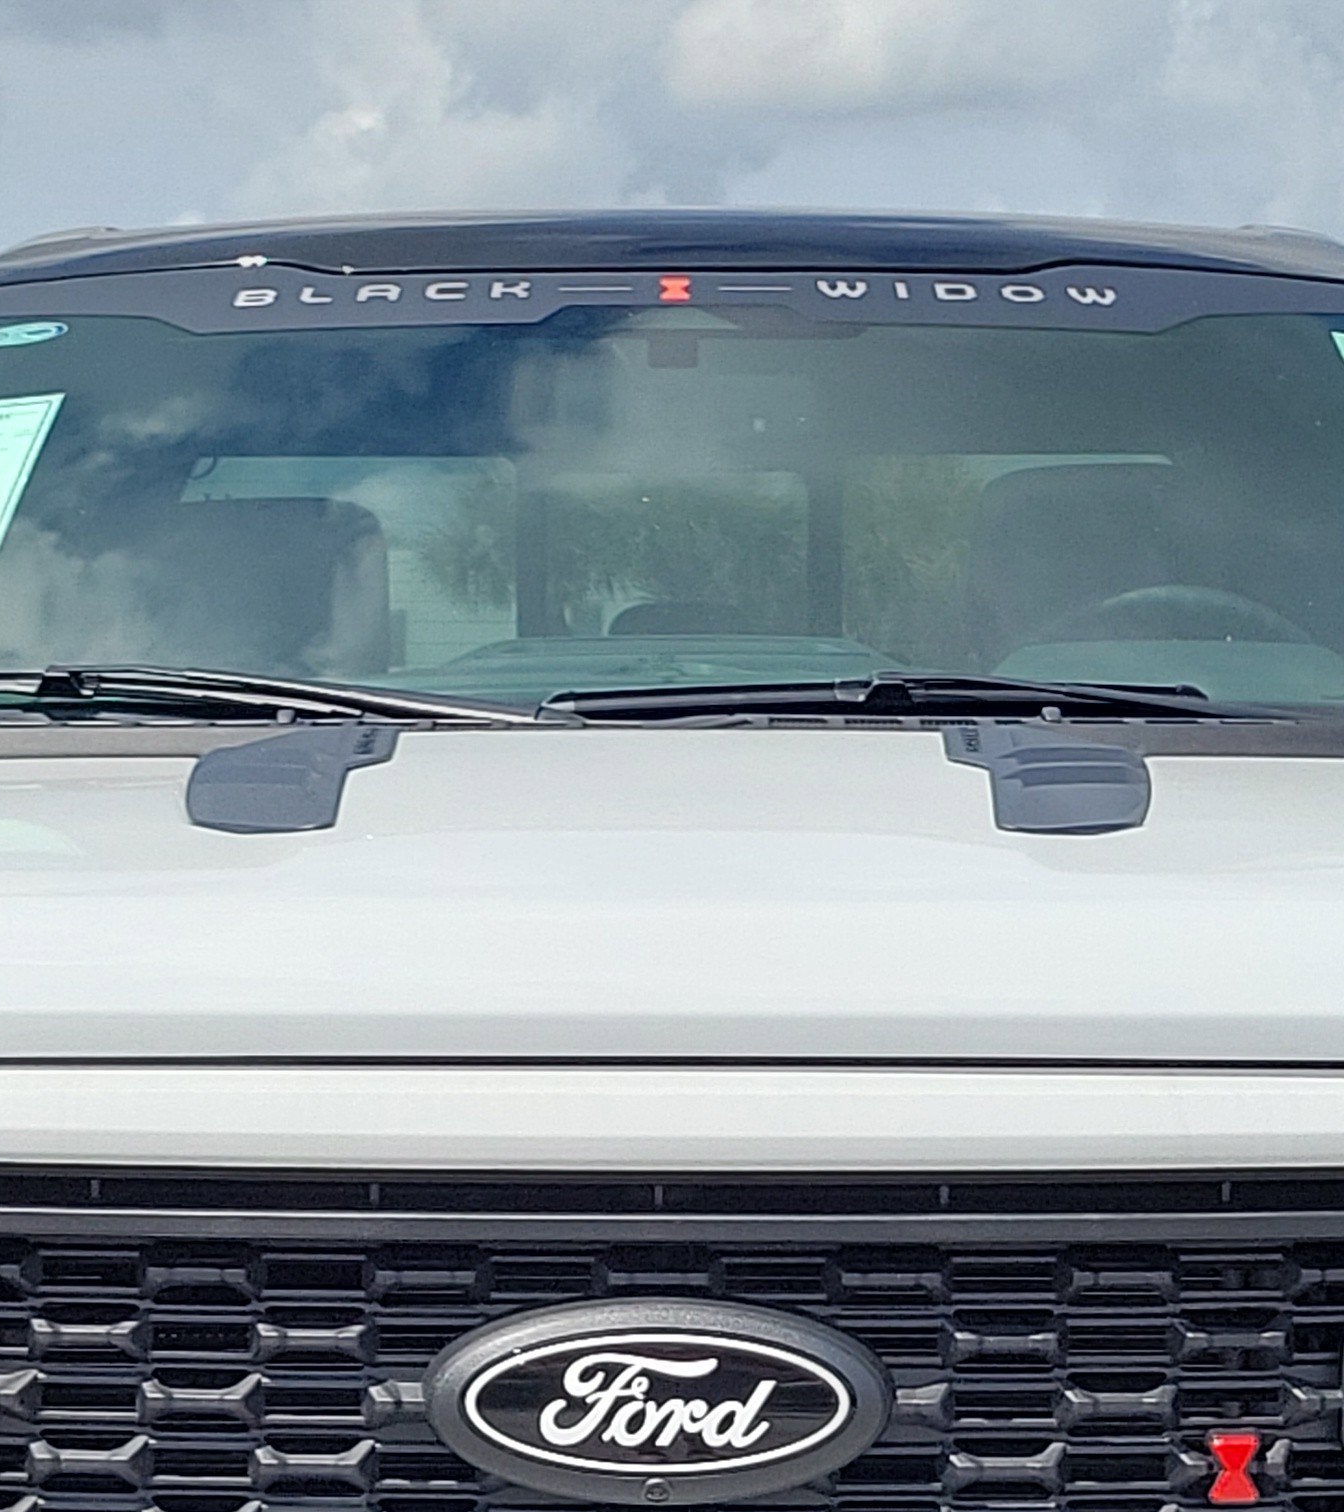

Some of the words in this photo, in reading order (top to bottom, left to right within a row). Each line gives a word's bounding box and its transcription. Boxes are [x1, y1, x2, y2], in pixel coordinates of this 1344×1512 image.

[233, 281, 531, 307] BLACK
[816, 280, 1117, 306] WIDOW
[539, 1352, 777, 1449] Ford
